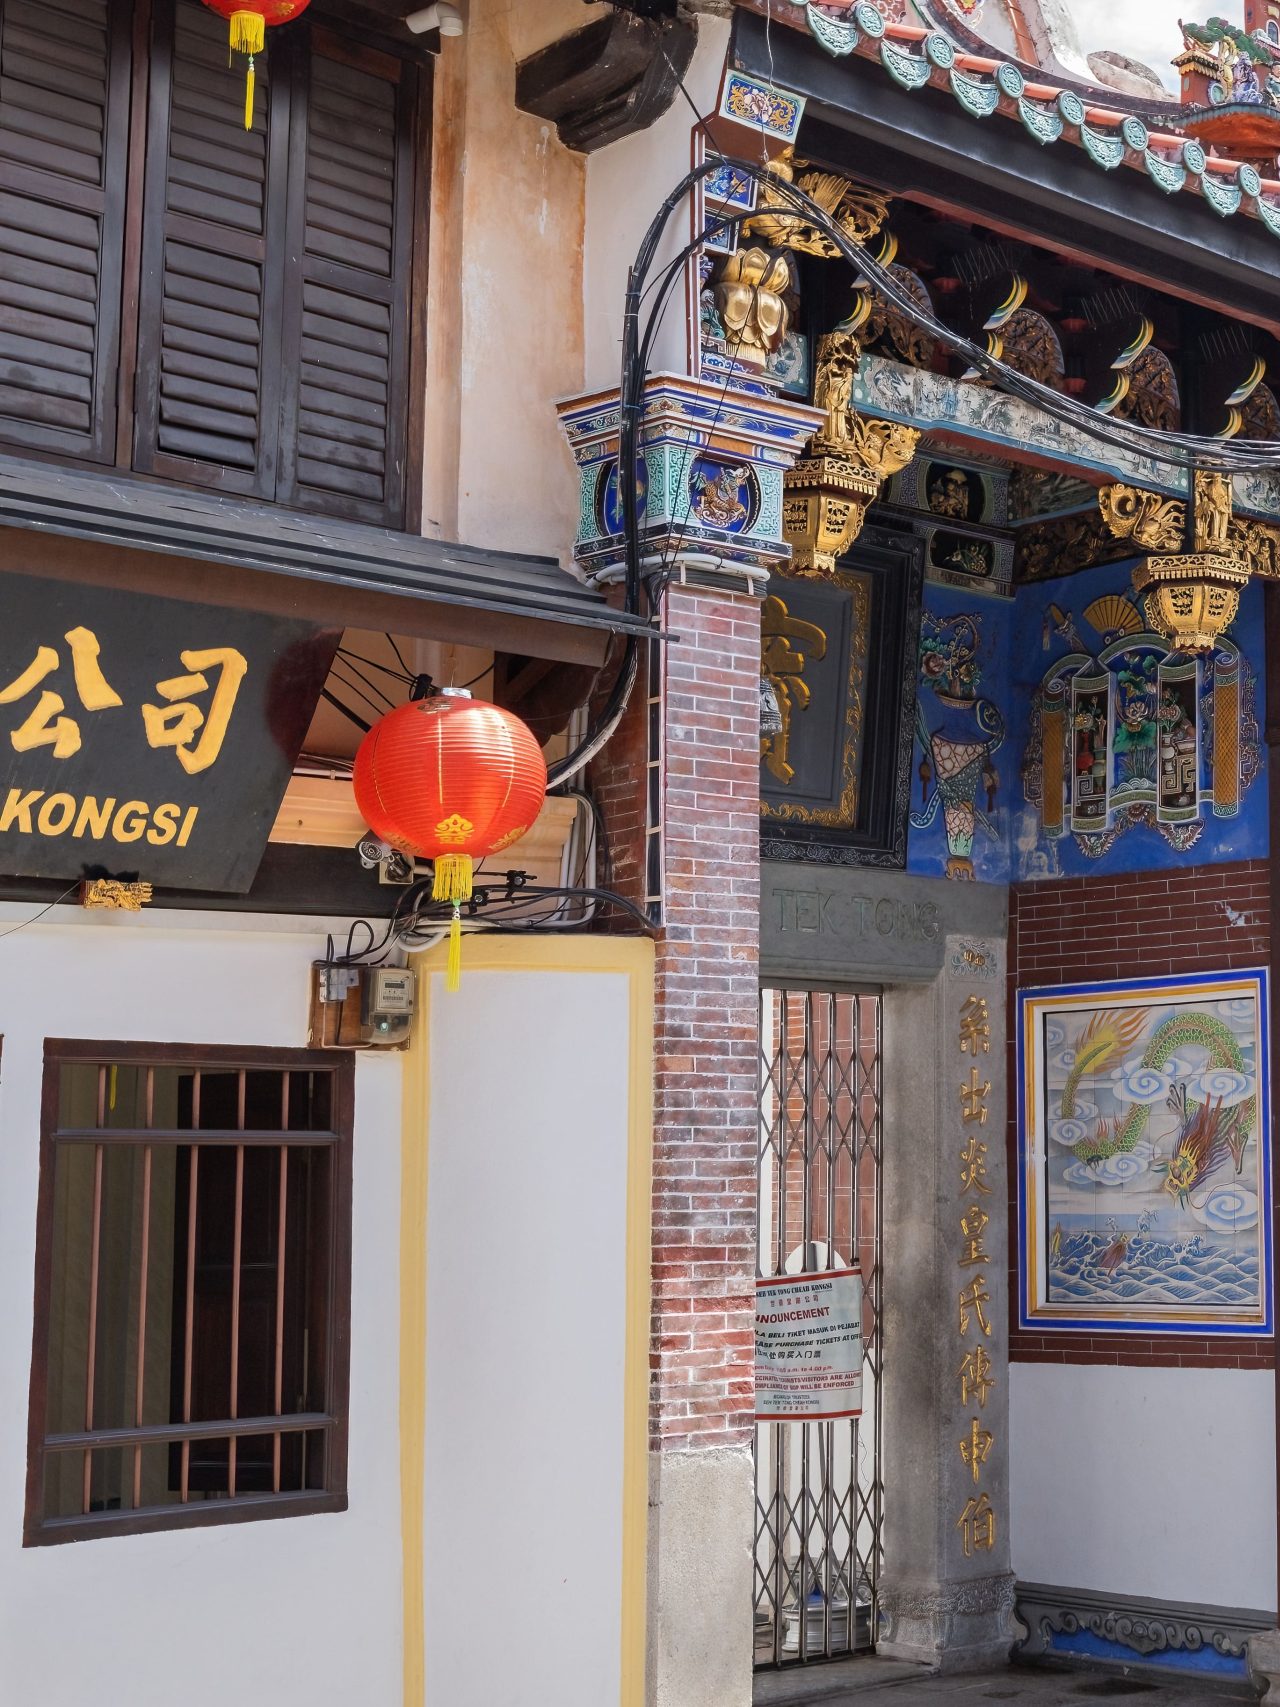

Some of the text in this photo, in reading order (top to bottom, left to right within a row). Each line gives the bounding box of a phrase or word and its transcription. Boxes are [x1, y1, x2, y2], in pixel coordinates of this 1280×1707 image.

[0, 626, 248, 774] 公司
[0, 789, 199, 847] KONGSI
[771, 888, 940, 942] TEK TONG
[787, 1329, 806, 1338] TIKET
[807, 1326, 828, 1335] MASUK
[816, 1336, 841, 1345] TICKETS
